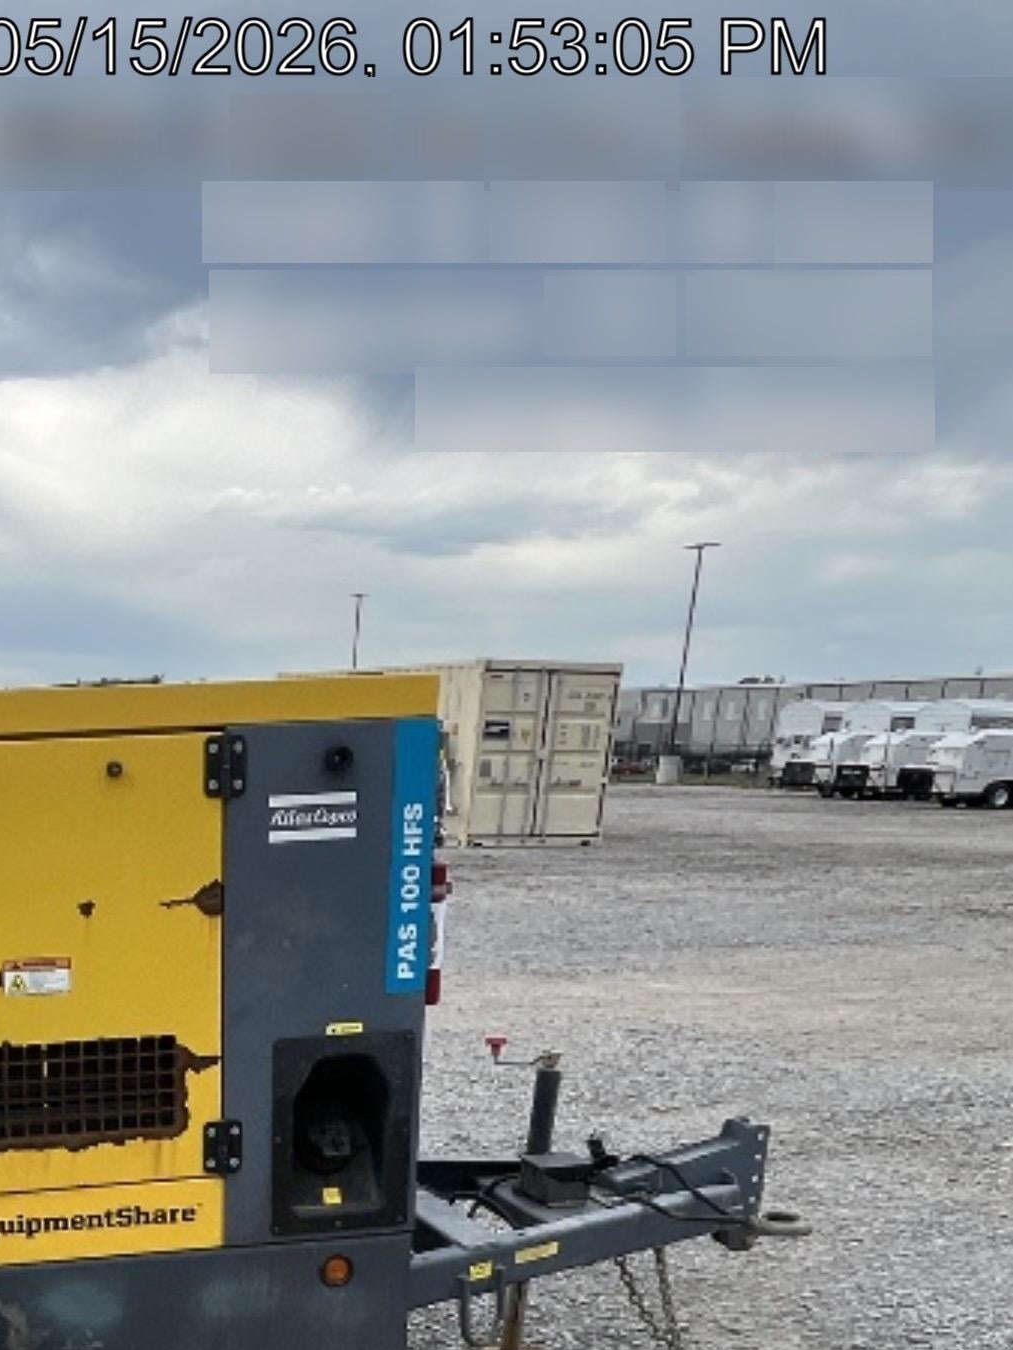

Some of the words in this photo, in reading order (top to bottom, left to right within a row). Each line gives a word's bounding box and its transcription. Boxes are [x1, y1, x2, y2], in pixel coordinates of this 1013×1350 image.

[403, 803, 424, 857] HFS
[401, 863, 421, 913] 100
[397, 923, 418, 979] PAS
